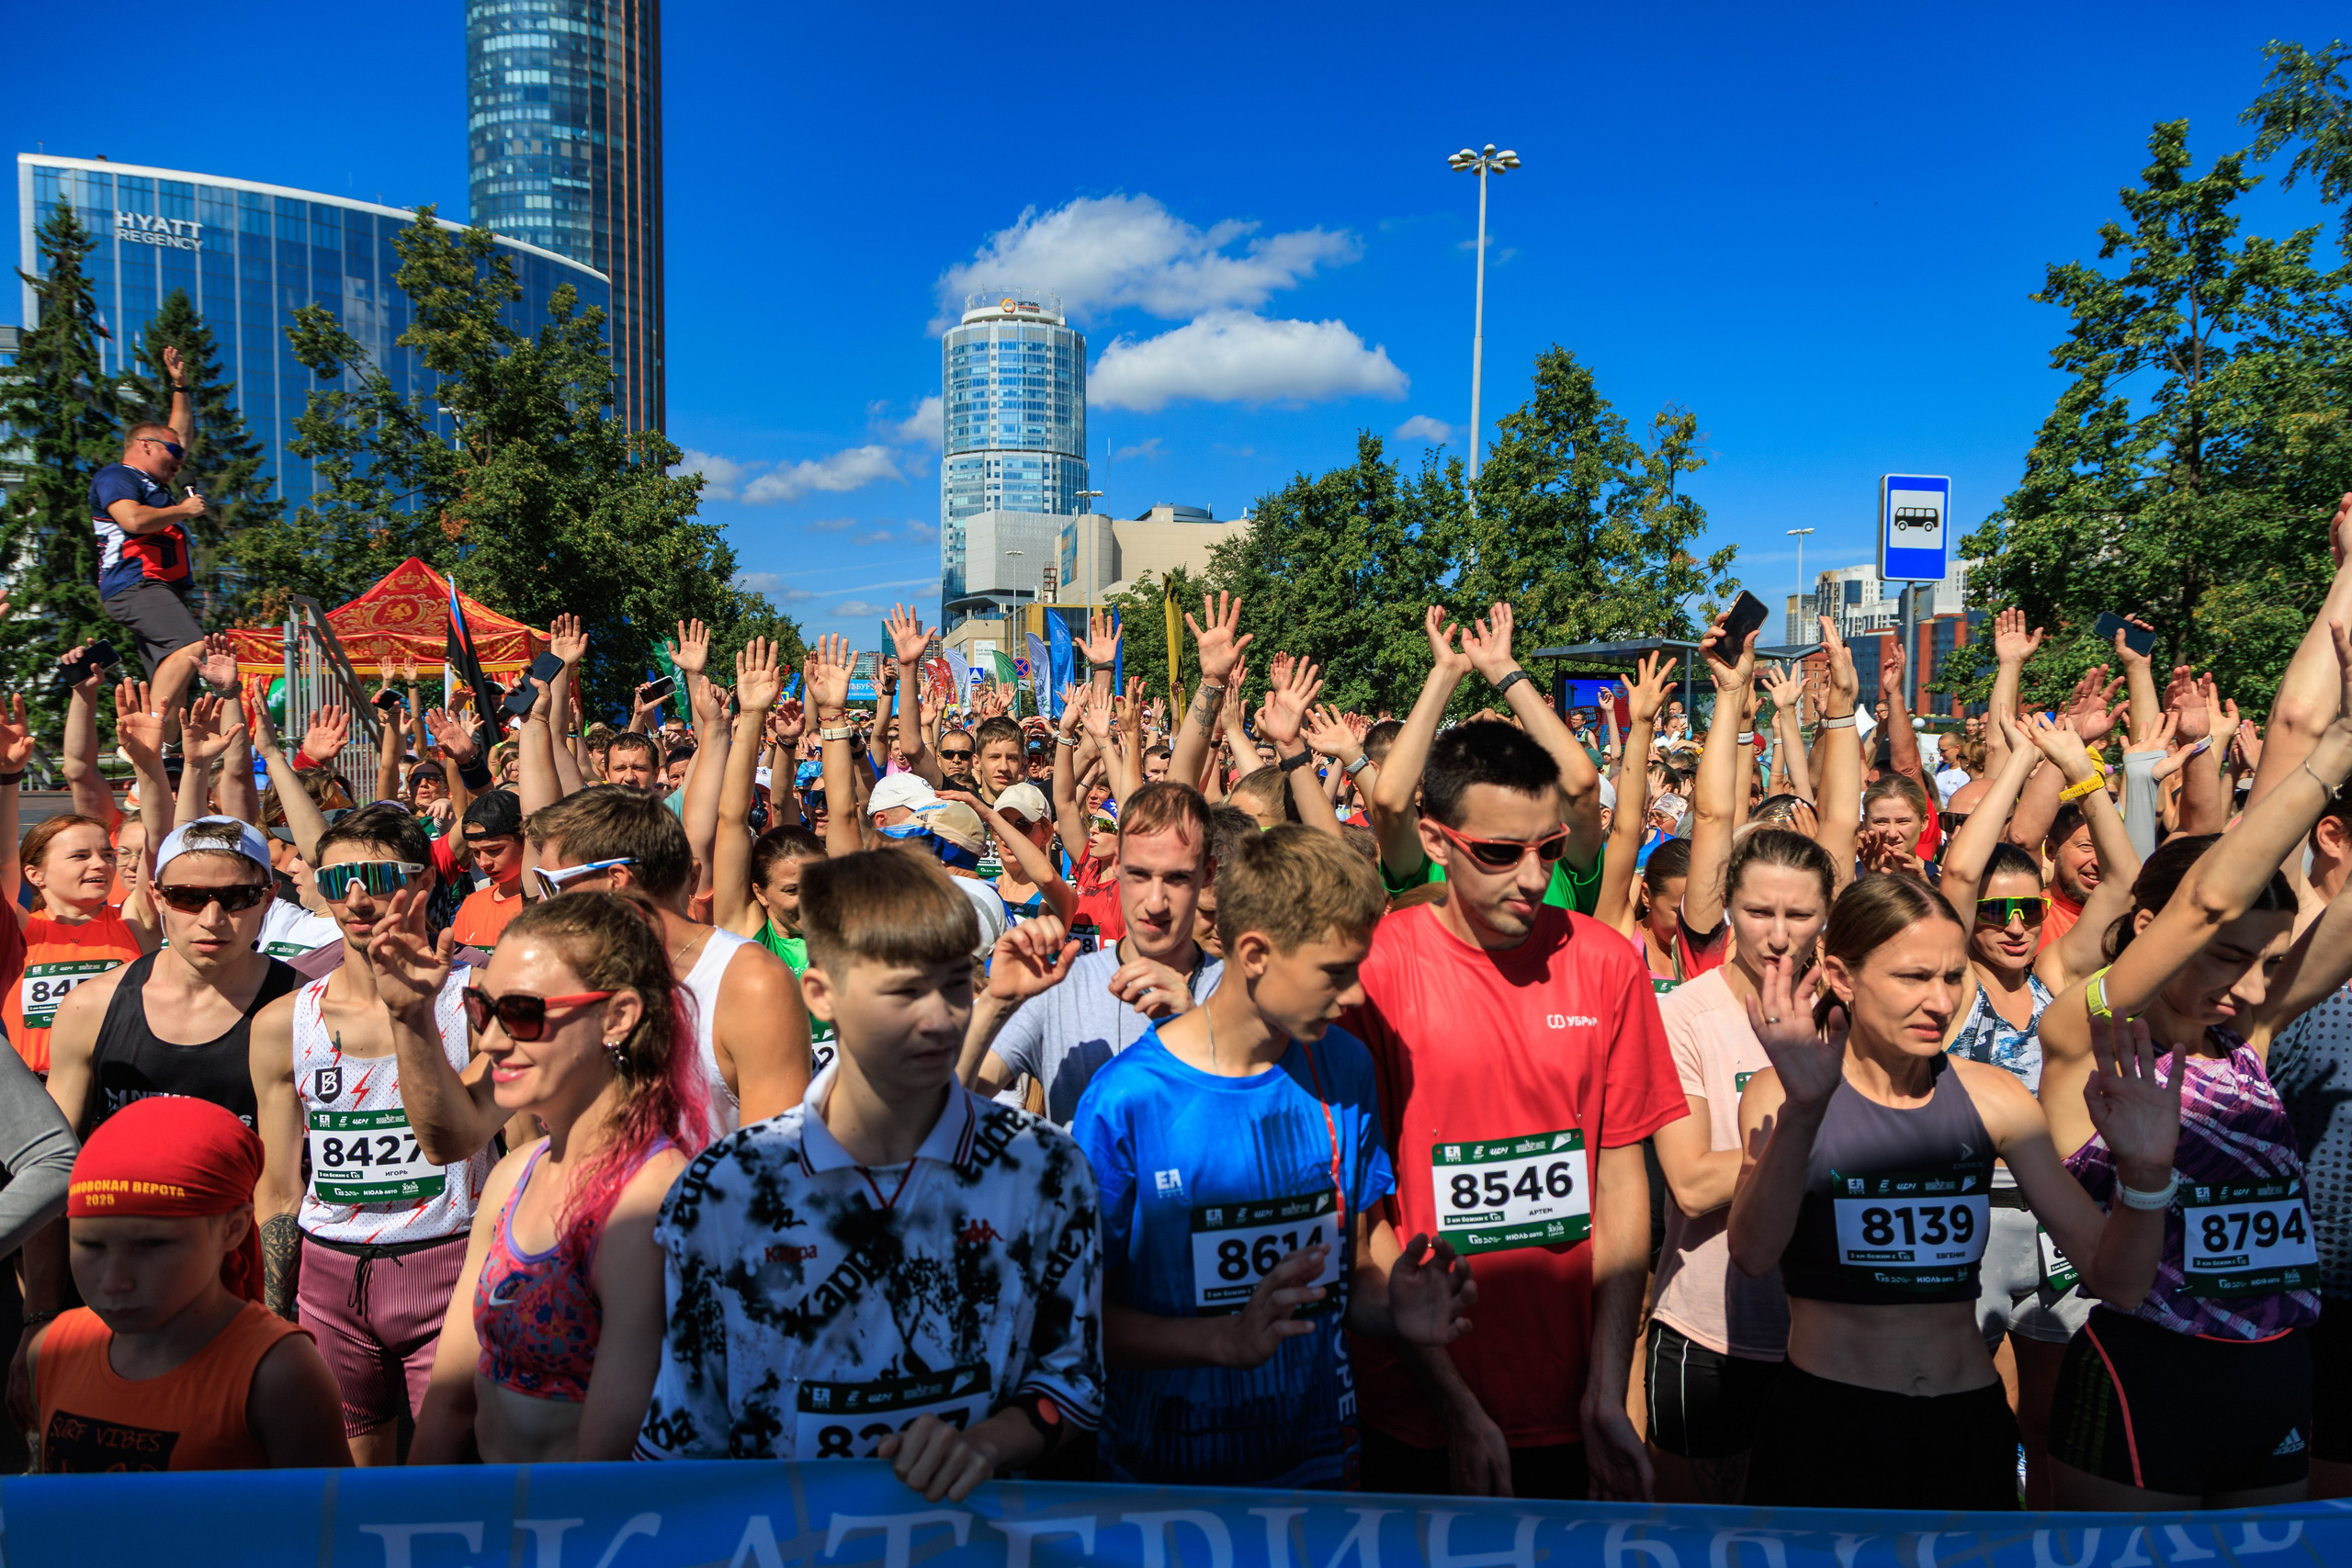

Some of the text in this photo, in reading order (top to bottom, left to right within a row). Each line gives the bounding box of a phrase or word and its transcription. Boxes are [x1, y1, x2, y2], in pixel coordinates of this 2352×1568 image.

[116, 210, 203, 239] HYATT
[116, 228, 204, 251] REGENCY
[31, 978, 90, 1002] 84
[322, 1133, 422, 1168] 8427
[132, 1181, 185, 1198] ВЕРСТА
[1451, 1161, 1574, 1210] 8546
[85, 1193, 115, 1207] 2025
[1529, 1208, 1553, 1216] АРТЕМ
[1506, 1233, 1529, 1241] ИЮЛЬ
[1861, 1204, 1974, 1247] 8139
[2201, 1207, 2307, 1253] 8794
[763, 1244, 819, 1264] Kappa
[1936, 1251, 1966, 1259] ЕВГЕНИЯ
[97, 1427, 163, 1452] VIBES
[2273, 1439, 2306, 1456] adidas
